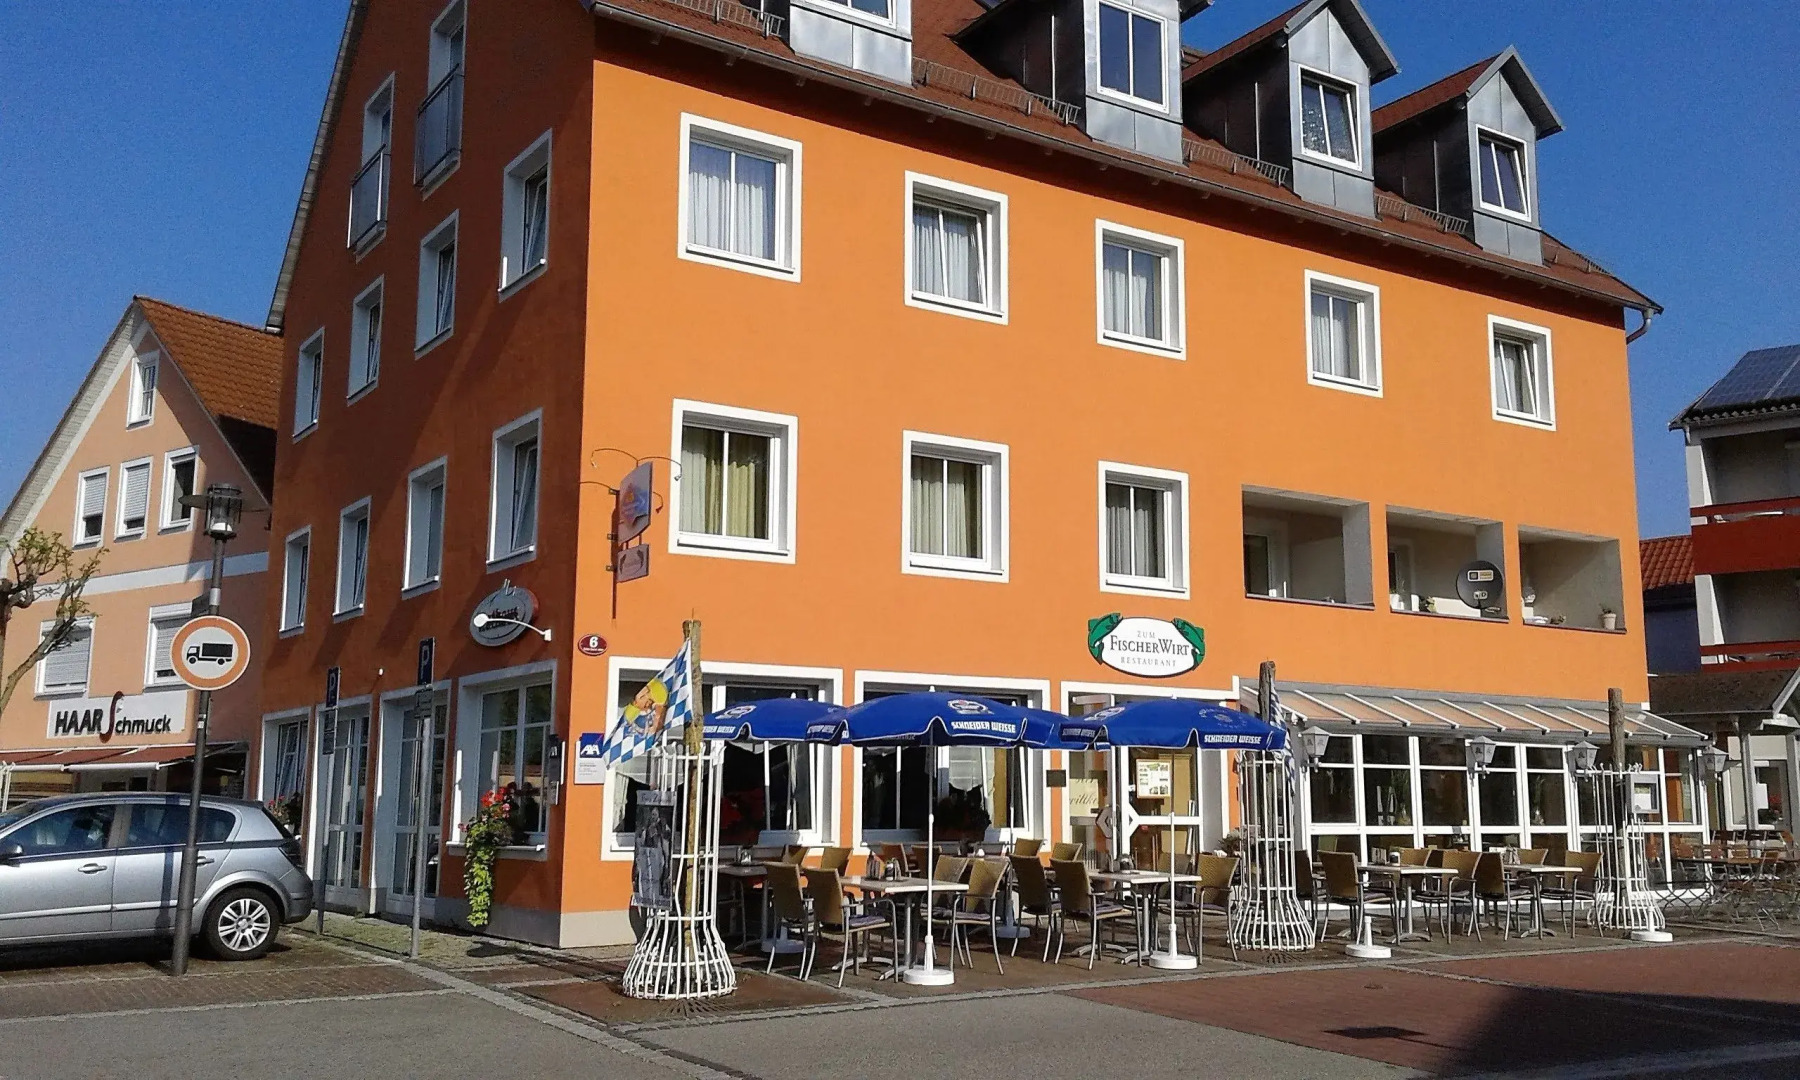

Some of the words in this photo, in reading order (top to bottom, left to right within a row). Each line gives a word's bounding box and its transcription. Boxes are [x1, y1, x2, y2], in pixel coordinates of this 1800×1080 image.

[1137, 630, 1156, 639] ZUM
[589, 636, 599, 648] 6
[420, 645, 430, 680] P
[1120, 656, 1176, 667] RESTAURANT
[951, 721, 991, 731] SCHNEIDER
[991, 721, 1016, 734] WEISSE
[1204, 734, 1239, 743] SCHNEIDER
[1238, 734, 1262, 745] WEISSE
[580, 743, 601, 756] AXA
